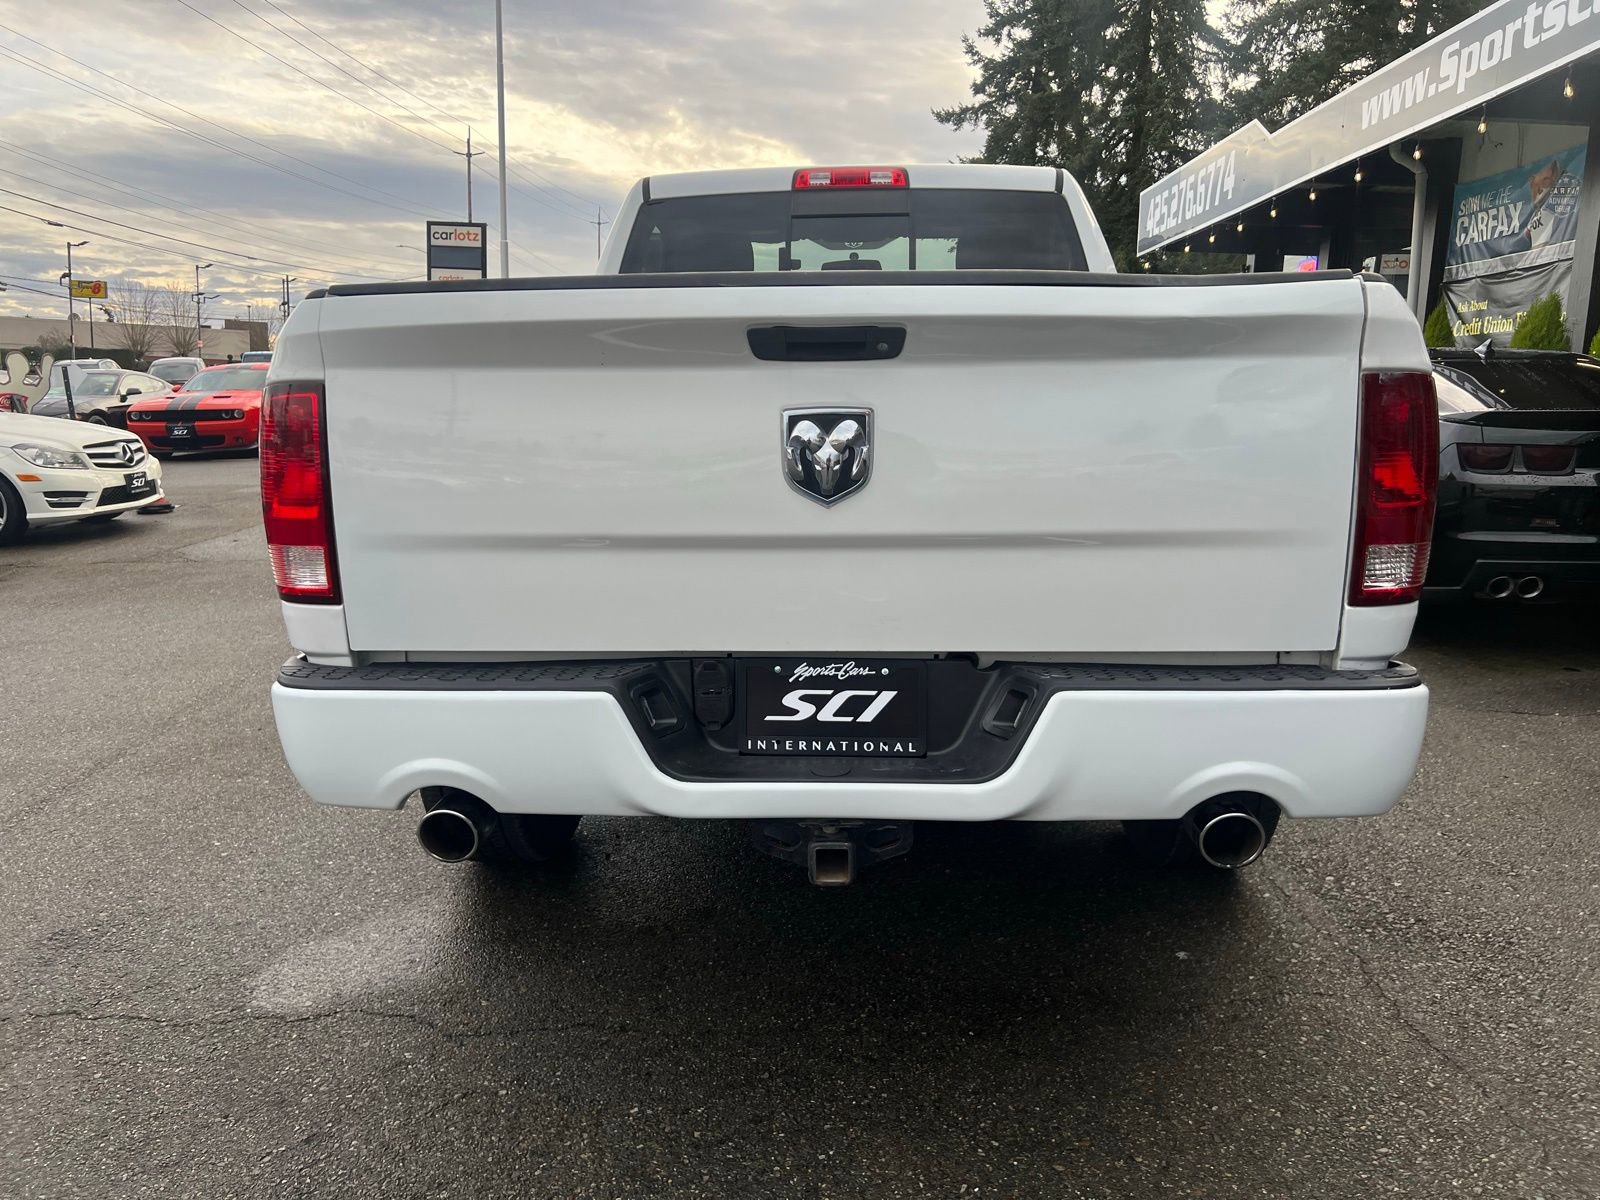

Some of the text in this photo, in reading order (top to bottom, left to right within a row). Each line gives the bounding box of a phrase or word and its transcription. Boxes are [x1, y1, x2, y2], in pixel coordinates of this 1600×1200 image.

[1146, 150, 1236, 238] 425.276.6774
[432, 228, 480, 241] carlotz
[1456, 202, 1522, 247] CARFAX
[1457, 299, 1489, 313] Ask About
[1453, 317, 1481, 337] Credit
[1483, 314, 1513, 334] Union
[788, 661, 876, 683] Sports Cars
[763, 689, 898, 723] SCI
[747, 739, 917, 752] INTERNATIONAL
